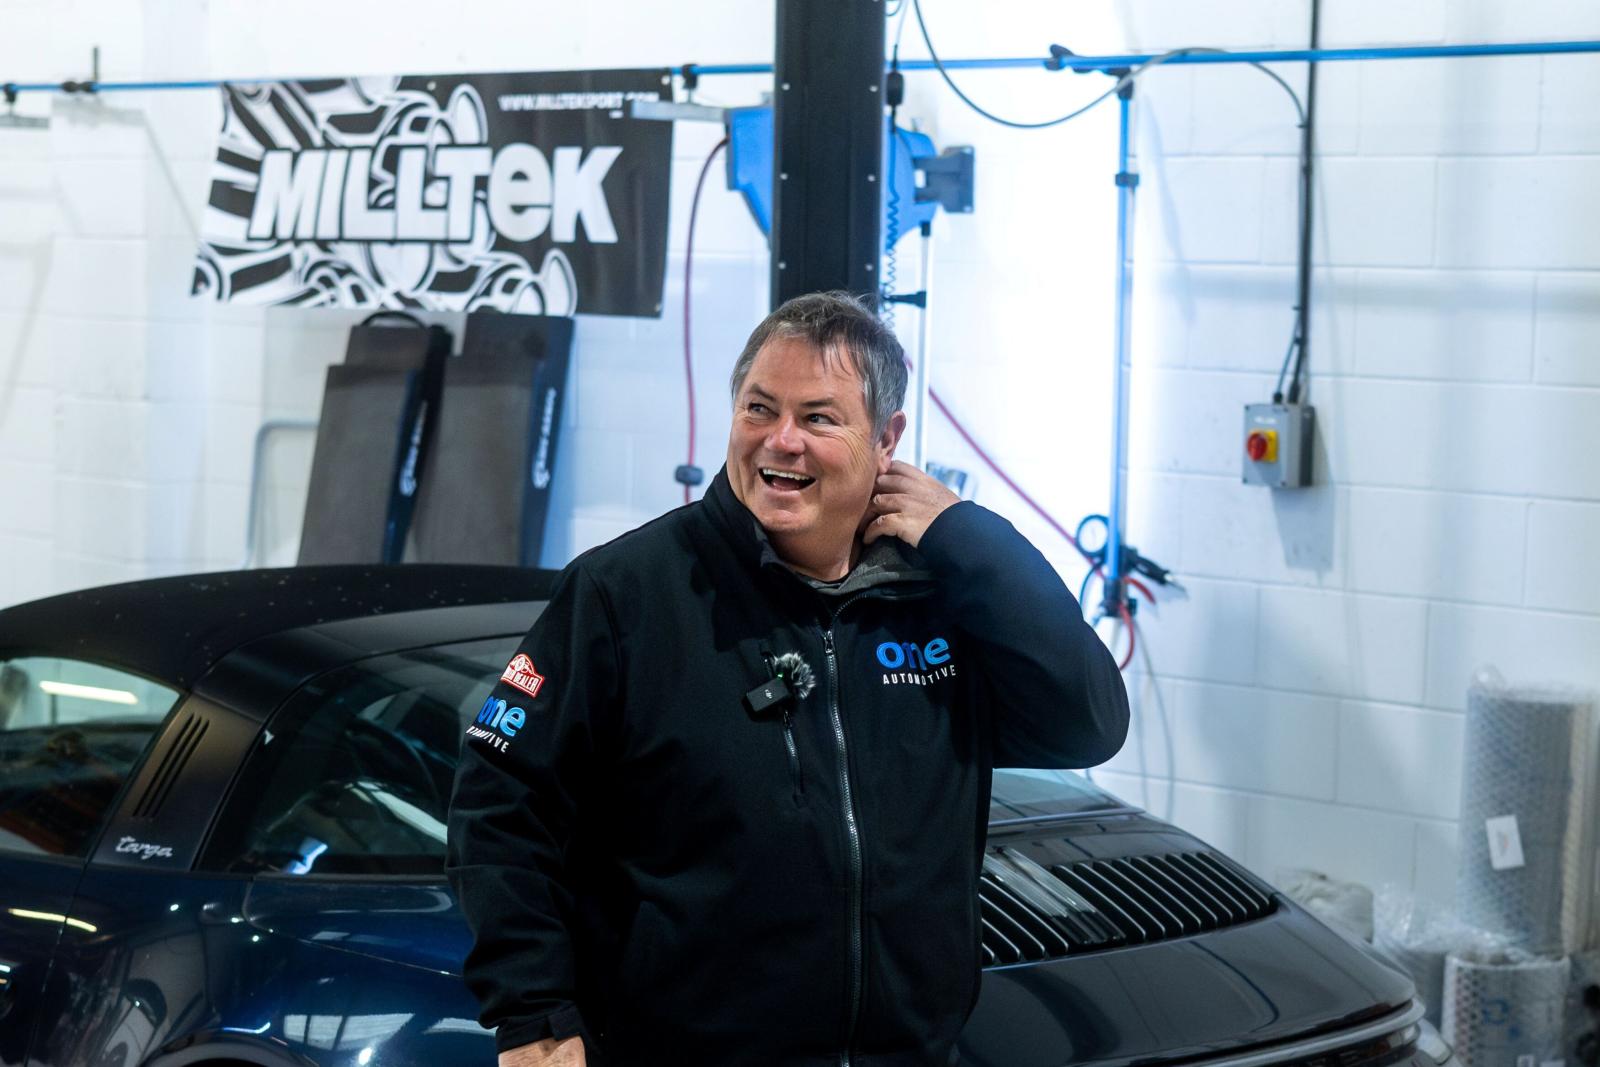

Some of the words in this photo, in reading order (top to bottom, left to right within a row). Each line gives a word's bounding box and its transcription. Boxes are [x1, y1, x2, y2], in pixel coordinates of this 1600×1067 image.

[877, 638, 951, 671] one
[882, 665, 956, 686] AUTOMOTIVE
[478, 696, 526, 736] one
[115, 836, 173, 859] targa
